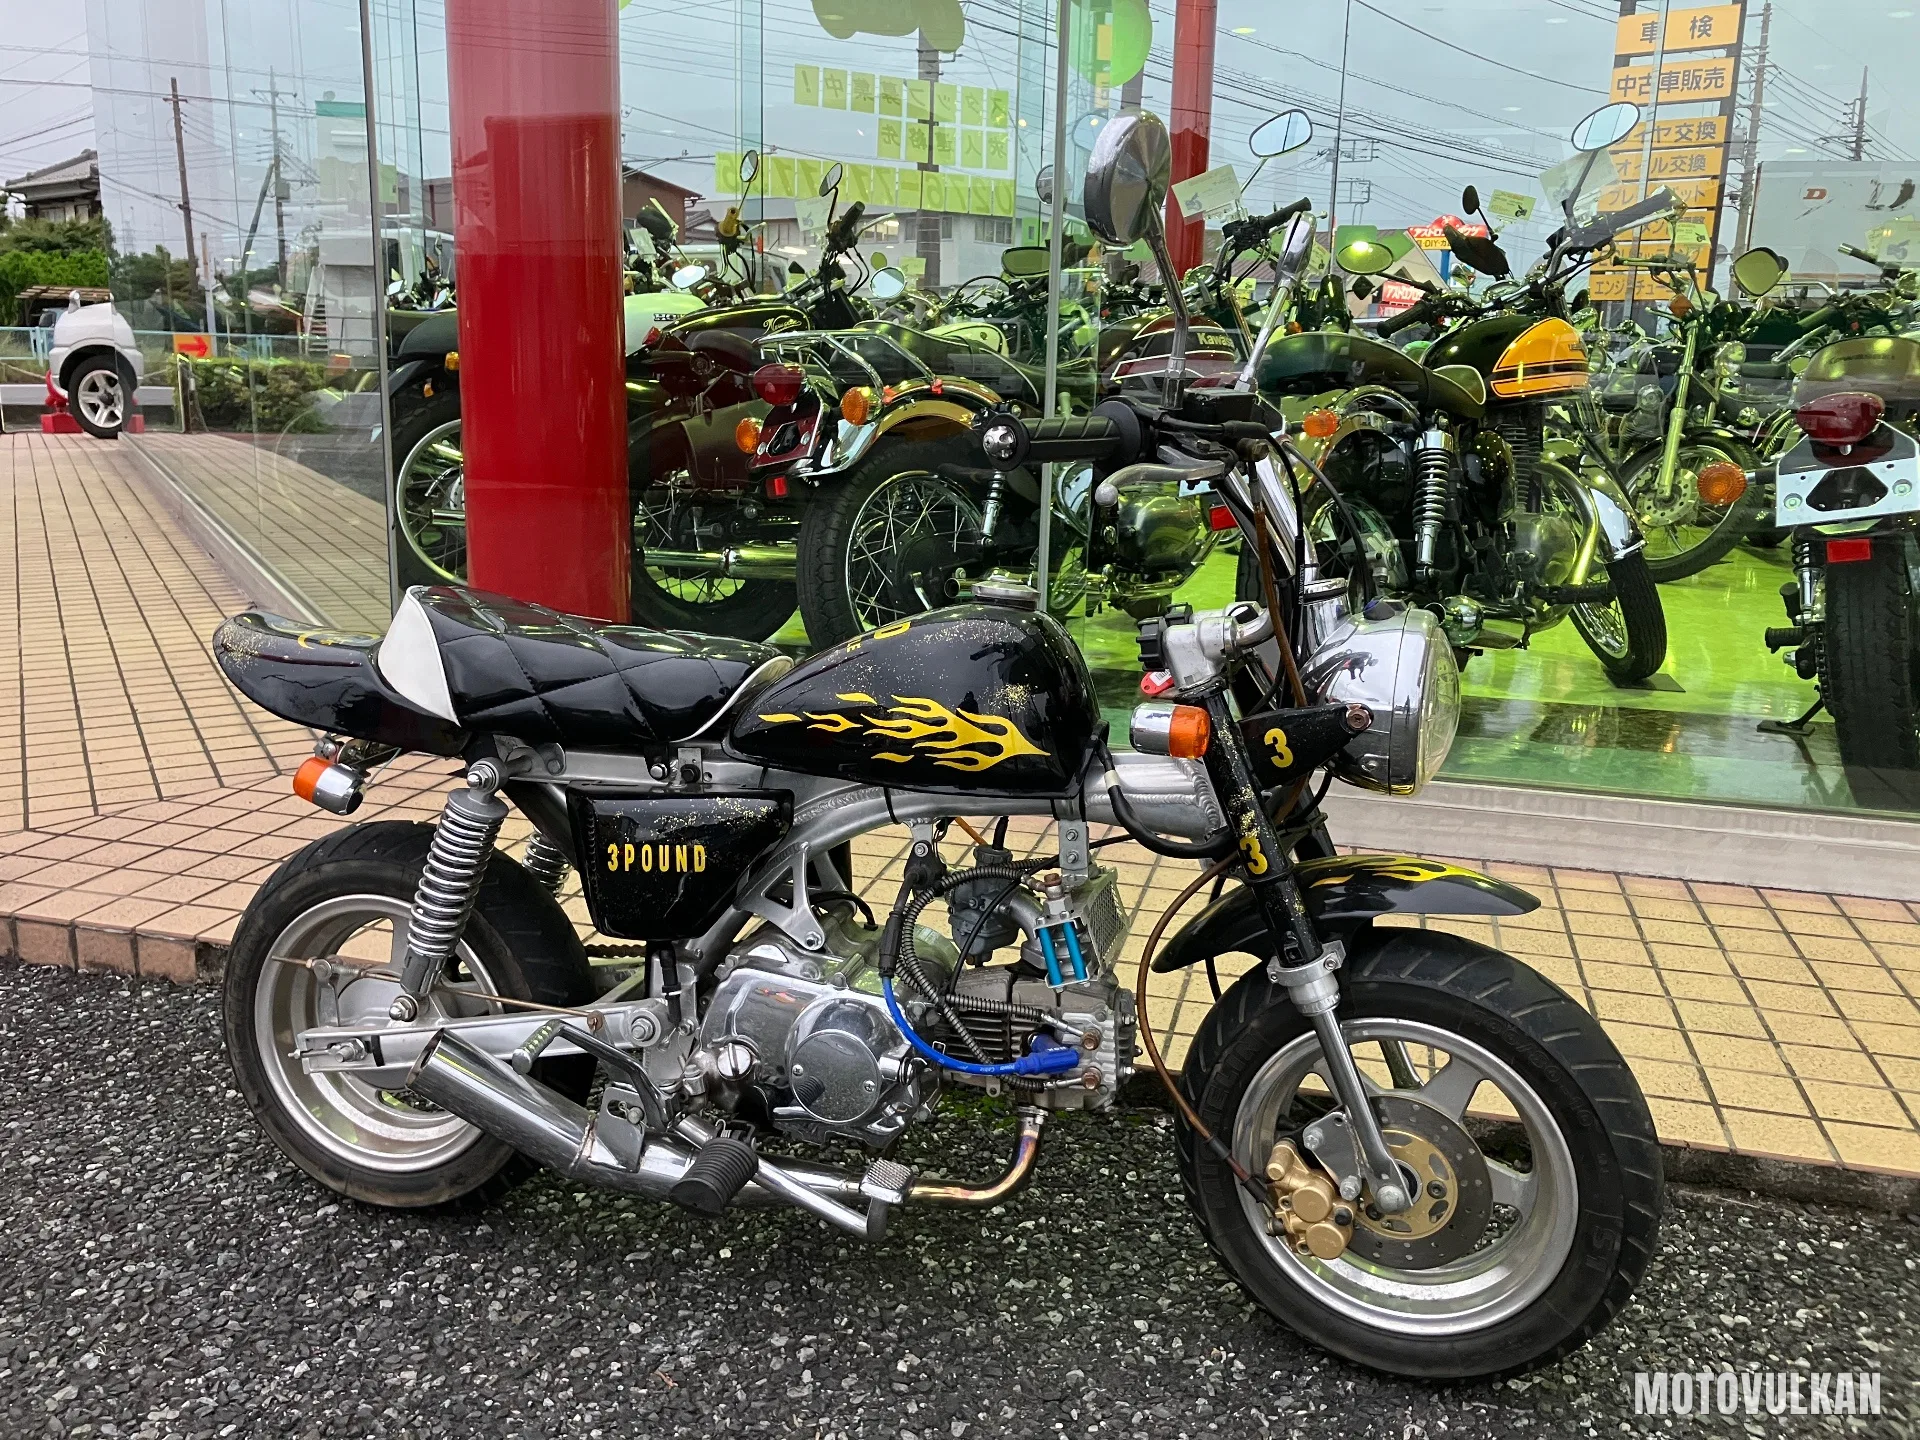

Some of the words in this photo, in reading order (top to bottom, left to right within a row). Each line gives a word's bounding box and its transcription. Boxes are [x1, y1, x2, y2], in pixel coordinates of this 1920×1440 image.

[1616, 66, 1726, 97] 中古車販売
[1616, 120, 1717, 145] イヤ交換
[1263, 727, 1294, 768] 3
[607, 843, 706, 873] 3POUND
[1239, 836, 1269, 875] 3
